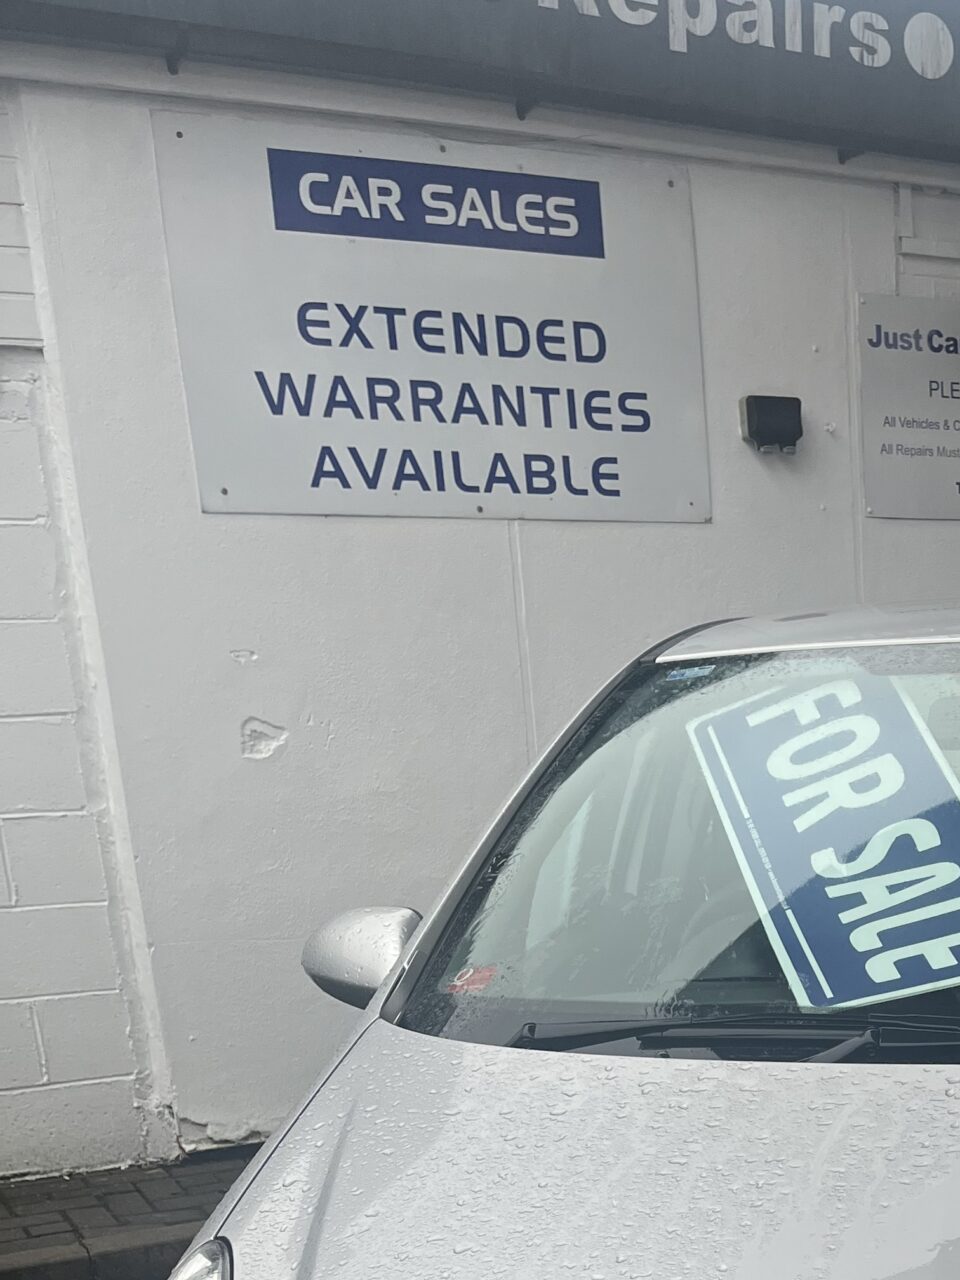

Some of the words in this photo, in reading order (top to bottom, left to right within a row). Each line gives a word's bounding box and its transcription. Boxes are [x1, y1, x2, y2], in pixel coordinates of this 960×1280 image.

[299, 172, 405, 222] CAR
[420, 183, 579, 238] SALES
[296, 301, 608, 364] EXTENDED
[867, 324, 923, 351] Just
[255, 370, 652, 433] WARRANTIES
[882, 415, 896, 428] All
[899, 416, 940, 431] Vehicles
[943, 419, 950, 431] &
[310, 446, 622, 498] AVAILABLE
[880, 443, 894, 455] All
[895, 443, 934, 458] Repairs
[936, 446, 960, 458] Must
[747, 679, 906, 832] FOR
